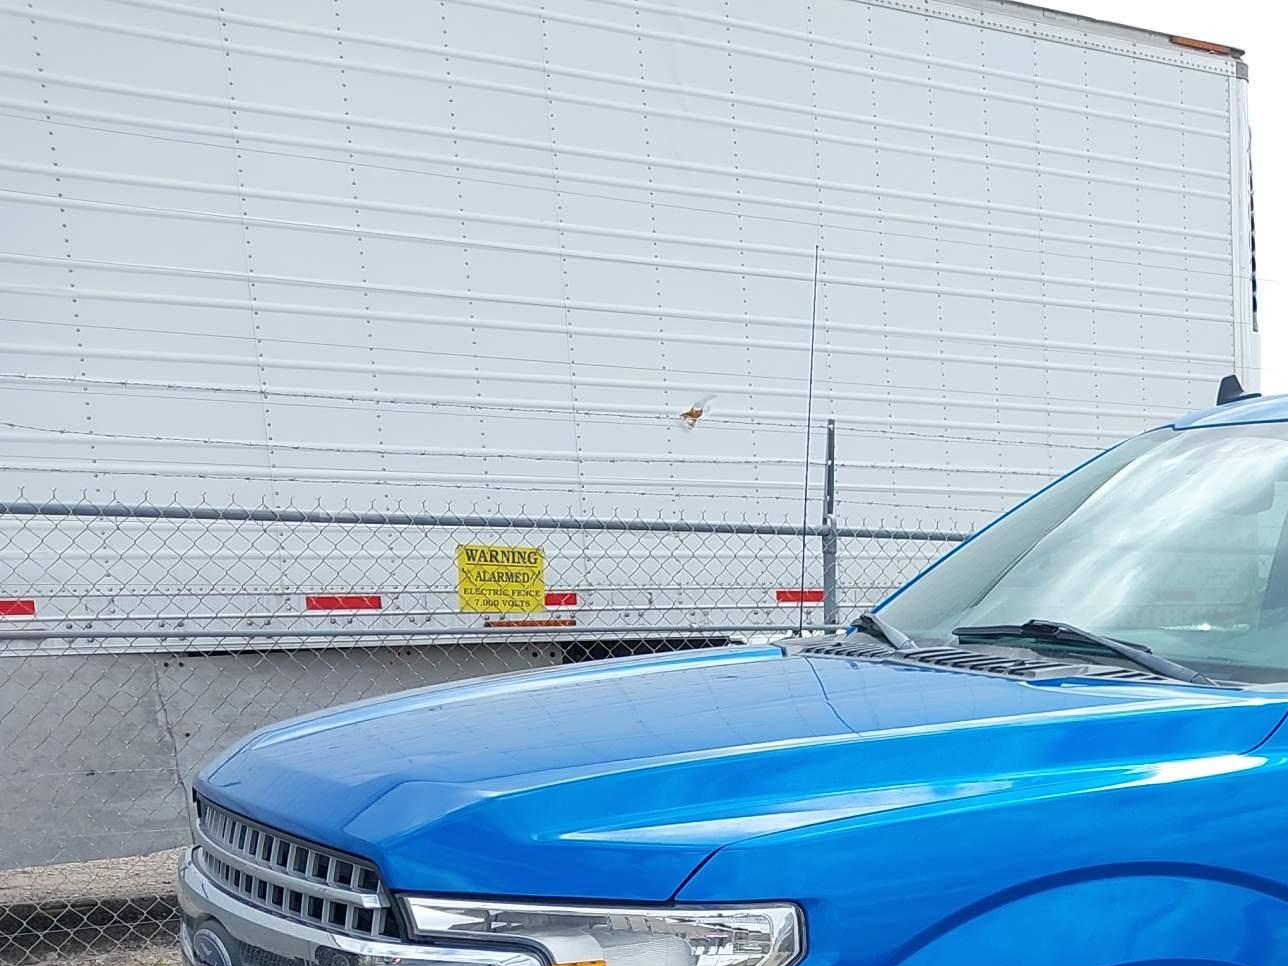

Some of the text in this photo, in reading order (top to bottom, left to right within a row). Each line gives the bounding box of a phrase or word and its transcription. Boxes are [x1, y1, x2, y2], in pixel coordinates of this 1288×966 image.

[465, 548, 539, 565] WARNING
[474, 570, 530, 584] ALARMED
[463, 587, 541, 598] ELECTRIC FENCE
[501, 599, 531, 608] VOLTS
